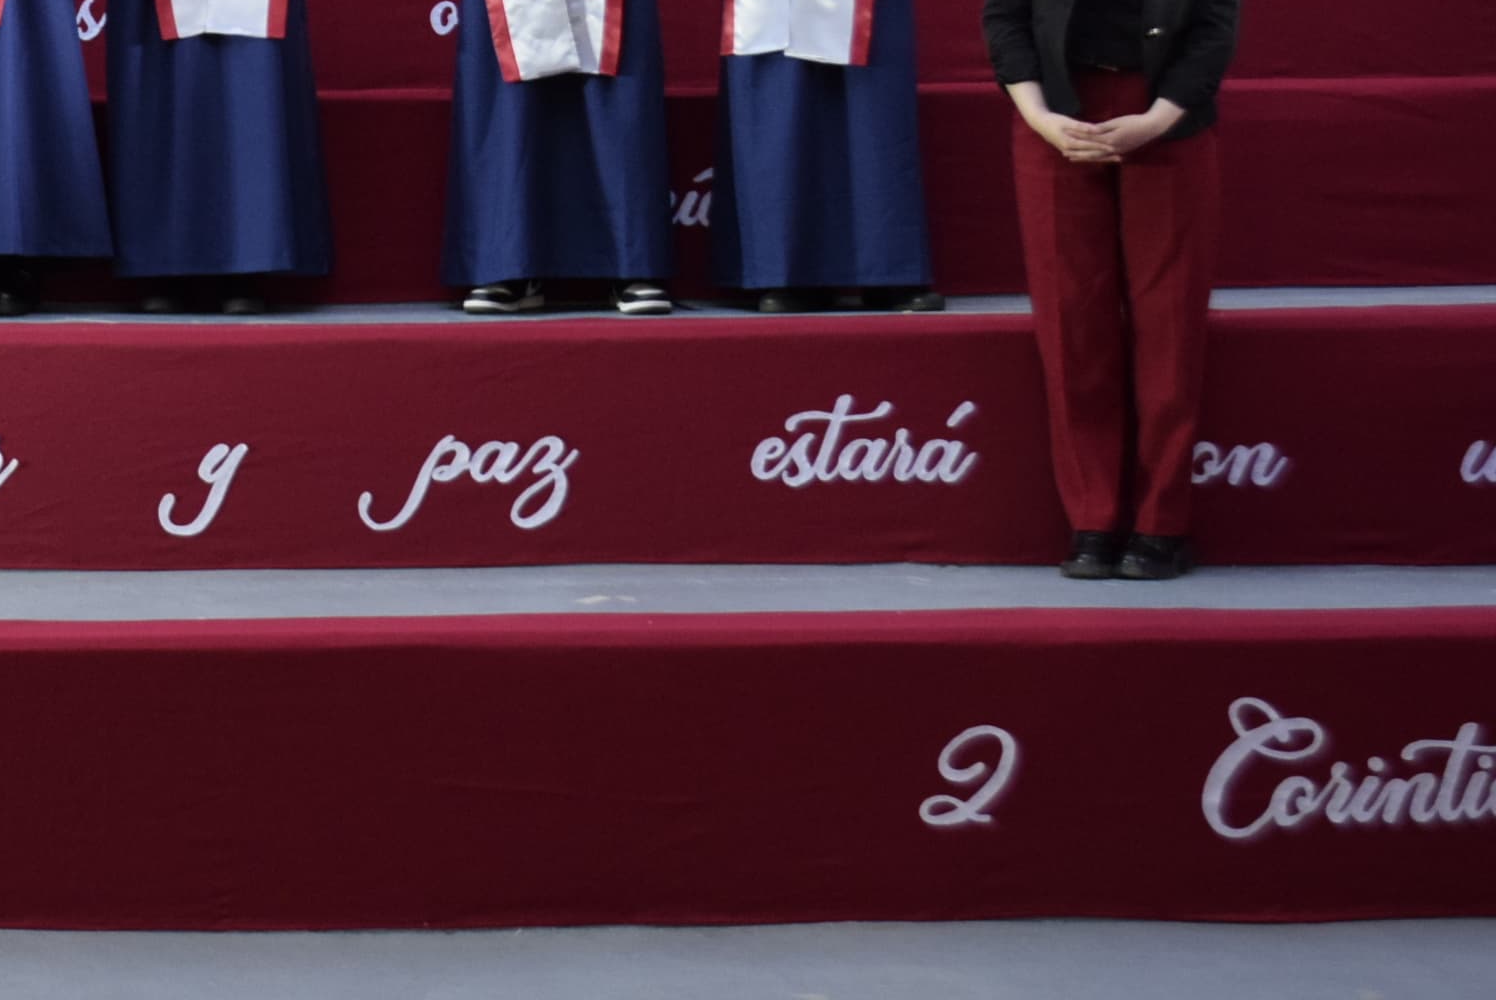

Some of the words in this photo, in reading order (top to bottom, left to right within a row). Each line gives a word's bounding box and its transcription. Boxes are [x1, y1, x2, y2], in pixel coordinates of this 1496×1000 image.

[158, 442, 248, 537] y
[358, 434, 580, 531] paz
[750, 394, 979, 488] estará
[1191, 441, 1289, 487] on
[919, 724, 1018, 826] 2
[1201, 697, 1496, 839] Corinti
